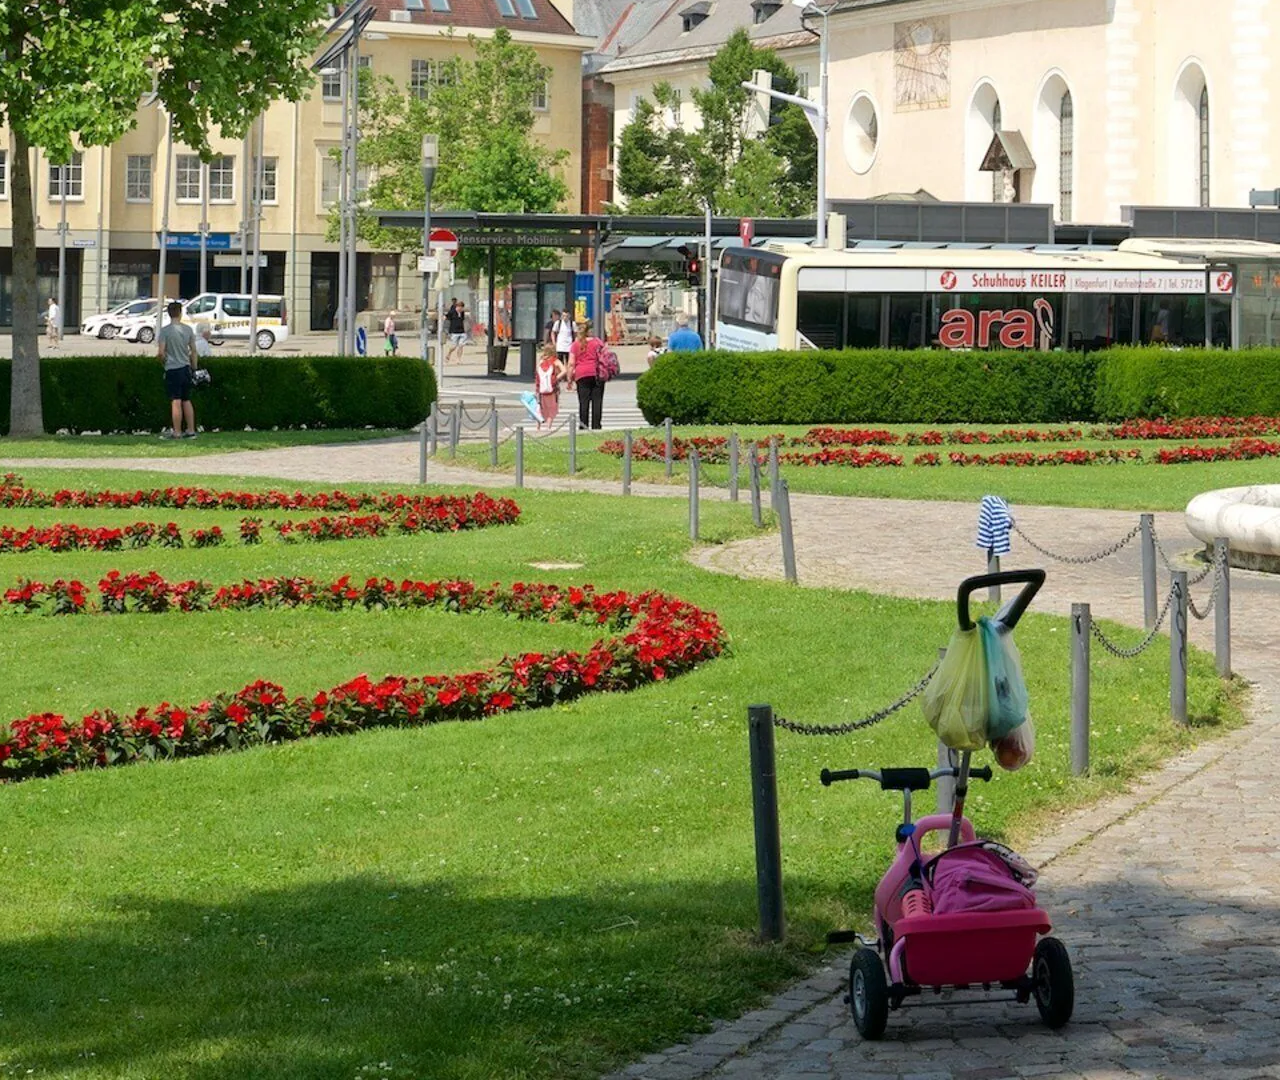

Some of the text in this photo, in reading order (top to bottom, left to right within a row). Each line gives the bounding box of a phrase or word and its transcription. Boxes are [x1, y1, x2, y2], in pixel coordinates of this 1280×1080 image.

[457, 233, 513, 245] denservice
[971, 272, 1027, 288] Schuhhaus
[1031, 273, 1066, 288] KEILER
[1075, 276, 1107, 290] Klagenfurt
[939, 308, 1036, 348] ara
